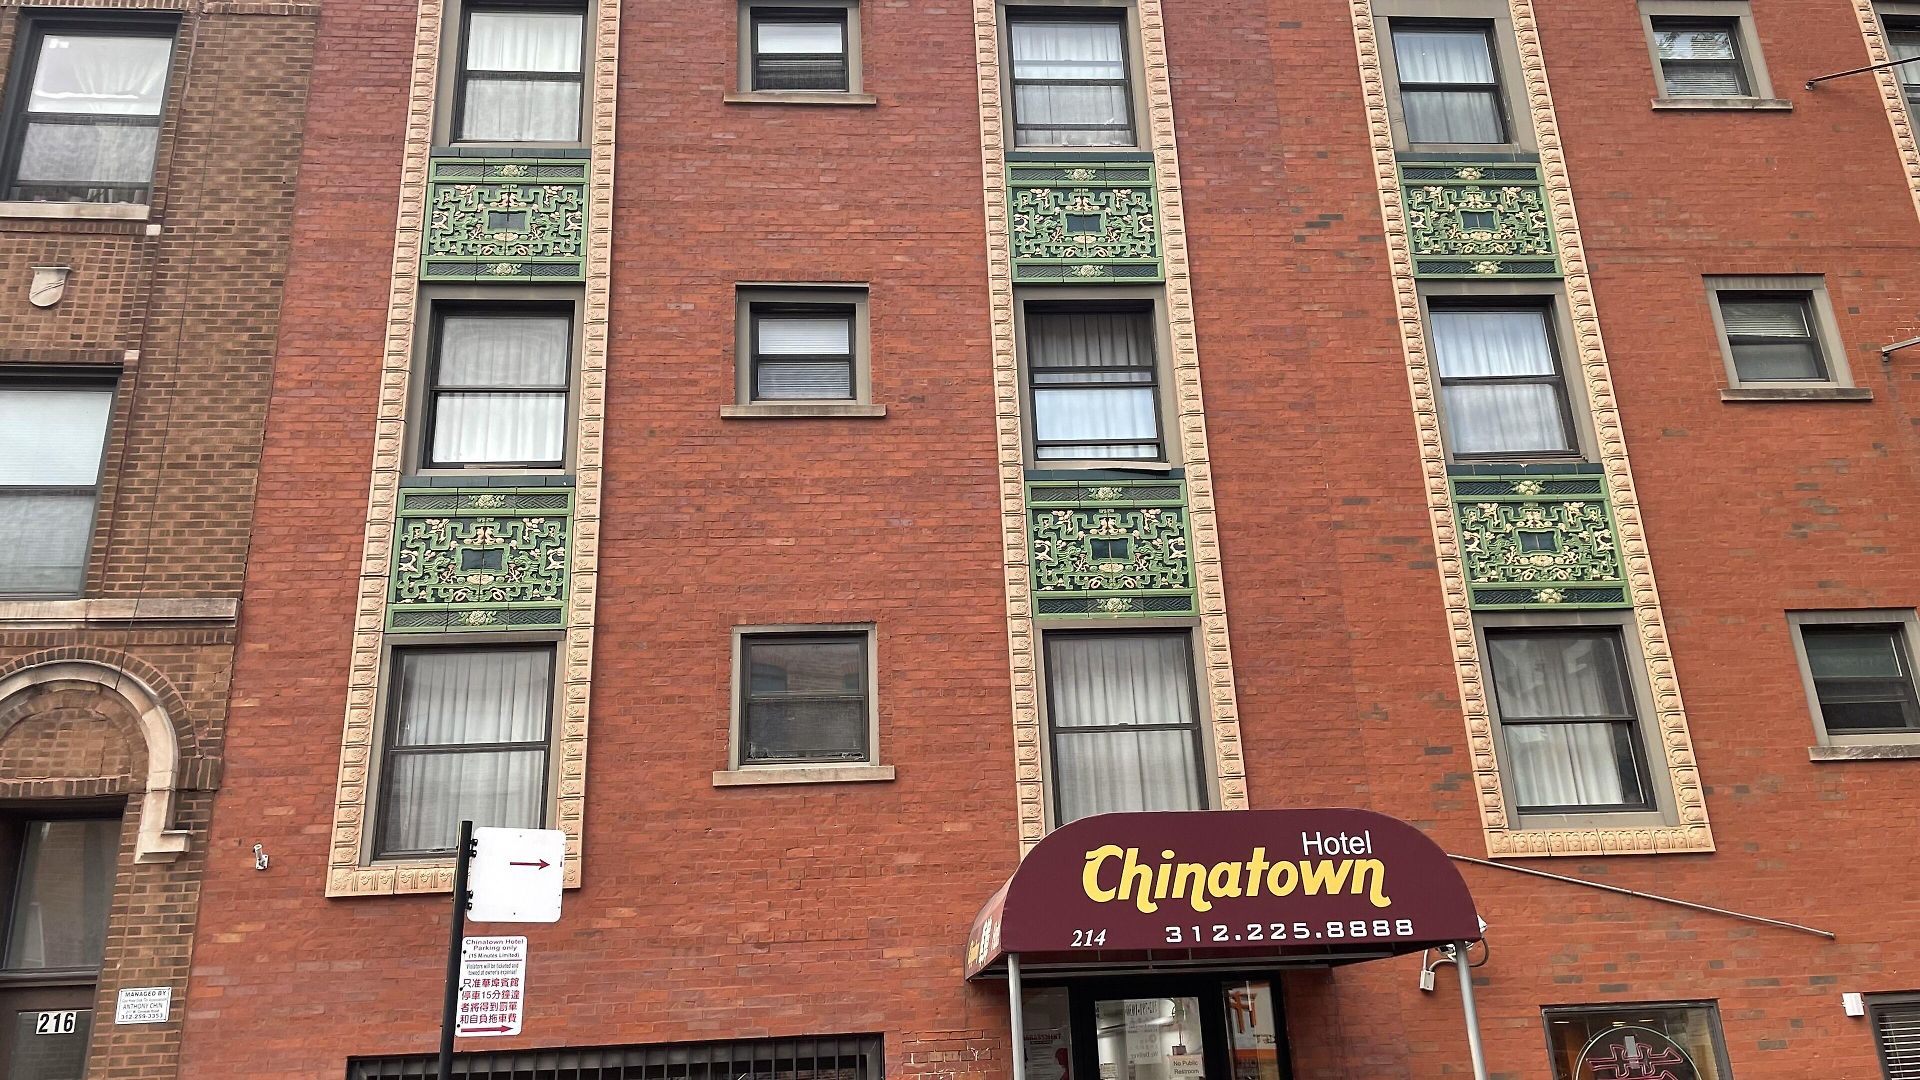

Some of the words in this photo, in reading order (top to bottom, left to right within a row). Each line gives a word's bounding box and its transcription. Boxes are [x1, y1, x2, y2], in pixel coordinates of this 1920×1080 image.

[1301, 830, 1373, 856] Hotel
[1082, 844, 1392, 914] Chinatown
[1070, 928, 1107, 947] 214
[1165, 919, 1414, 944] 312.225.8888
[38, 1012, 75, 1033] 216
